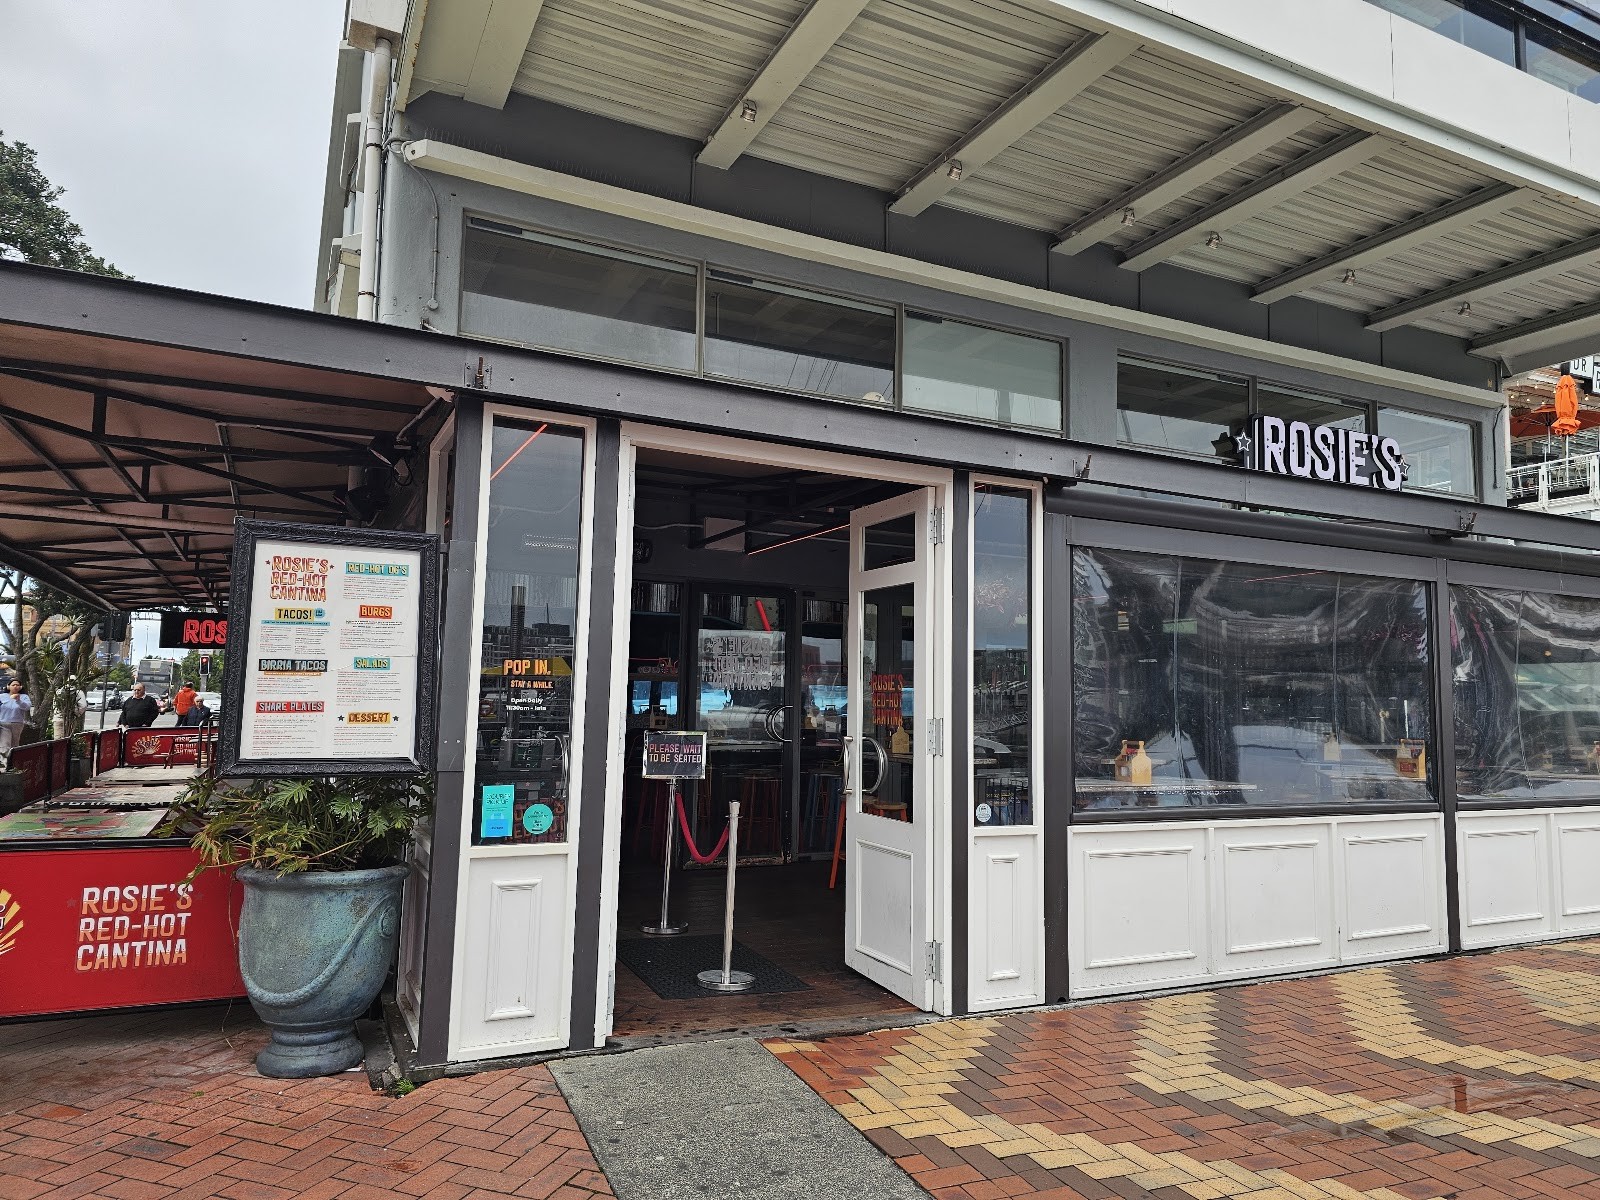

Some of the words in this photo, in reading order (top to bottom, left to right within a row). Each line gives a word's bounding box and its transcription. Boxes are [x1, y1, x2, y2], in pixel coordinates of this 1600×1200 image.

[1262, 415, 1402, 490] ROSIE'S
[271, 556, 328, 573] ROSIE'S
[271, 572, 328, 587] RED-HOT
[270, 585, 327, 602] CANTINA
[277, 608, 312, 620] TACOS!
[360, 606, 391, 617] BURGS
[260, 659, 292, 671] BIRRIA
[294, 660, 326, 671] TACOS
[355, 658, 388, 669] SALADS
[503, 659, 531, 676] POP
[510, 680, 526, 688] STAY
[259, 702, 288, 711] SHARE
[290, 702, 323, 711] PLATES
[348, 712, 390, 723] DESSERT
[649, 743, 680, 753] PLEASE
[683, 744, 702, 754] WAIT
[649, 753, 659, 762] TO
[660, 754, 671, 762] BE
[673, 754, 702, 763] SEATED
[81, 883, 194, 915] ROSIE'S
[78, 912, 192, 942] RED-HOT
[76, 938, 187, 971] CANTINA
